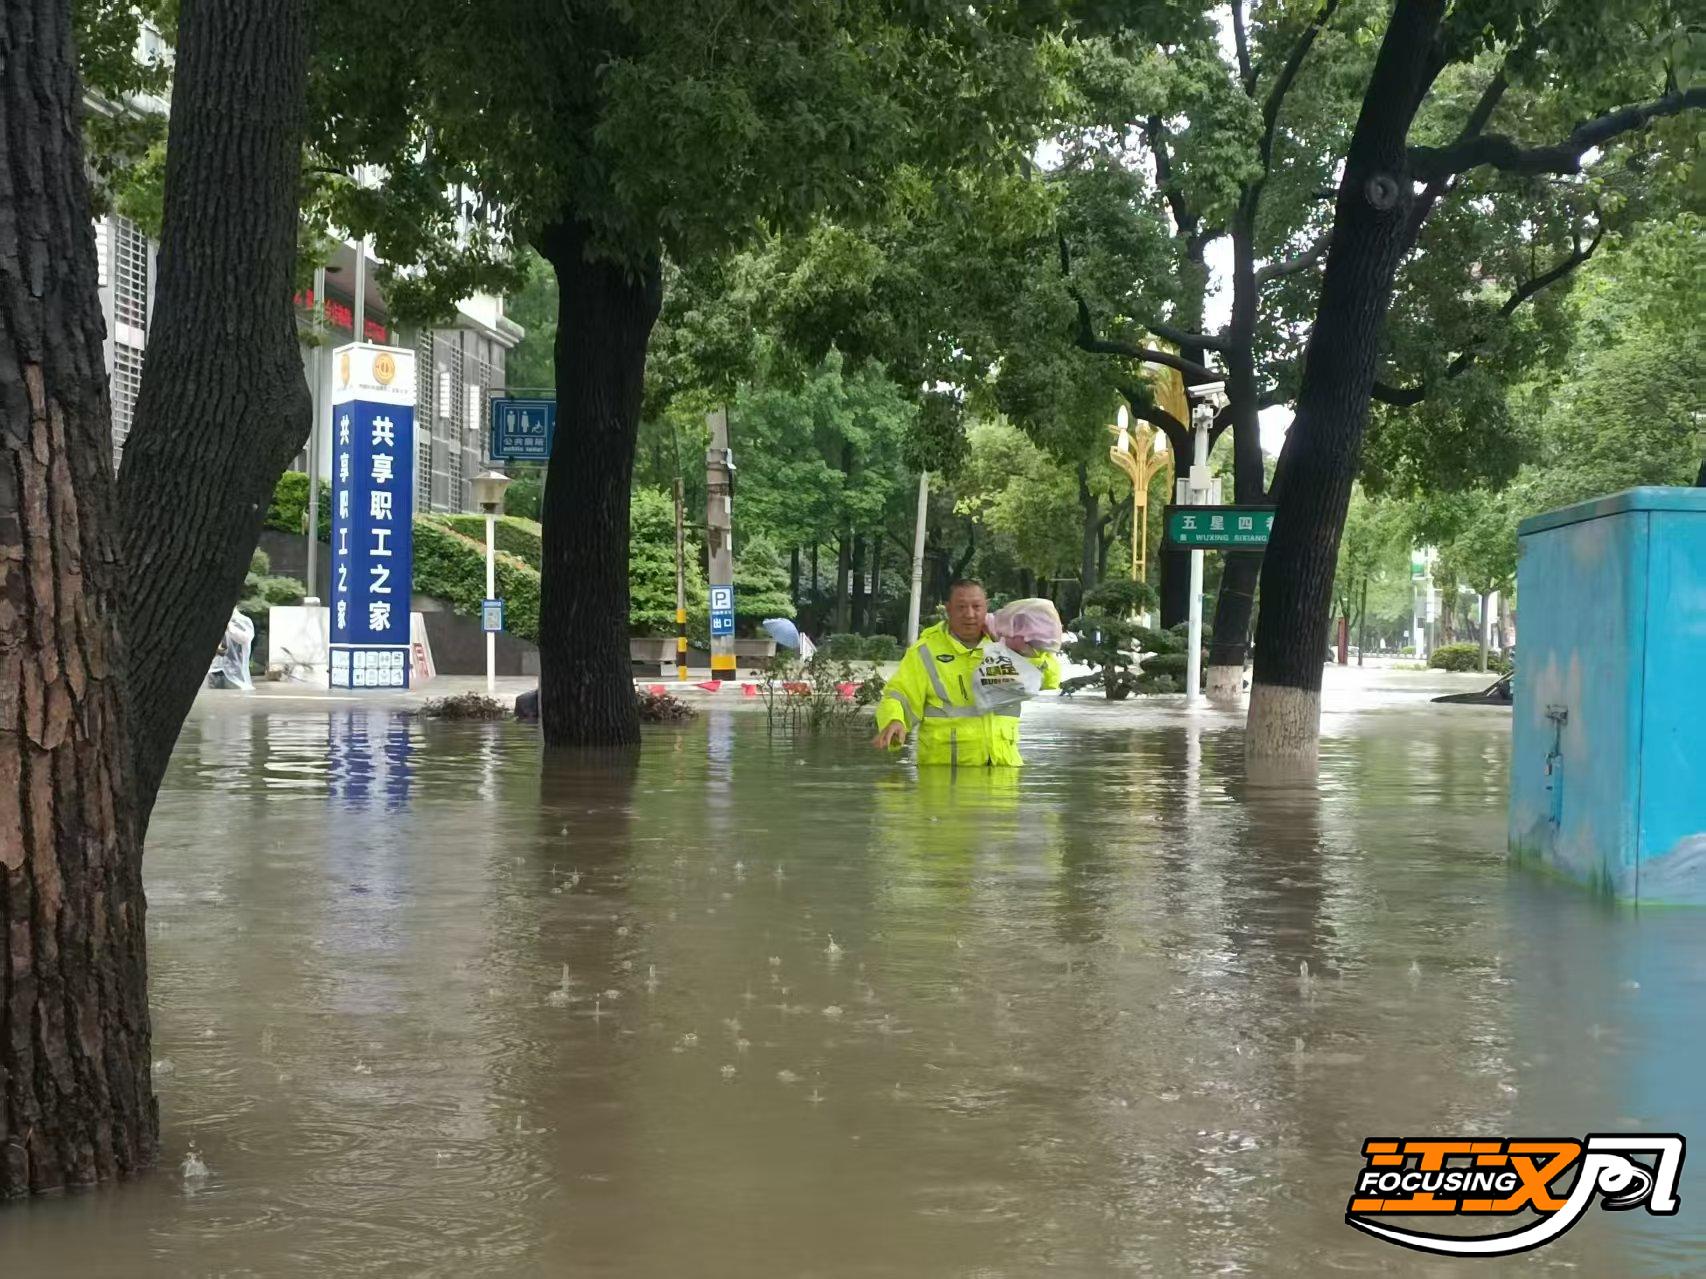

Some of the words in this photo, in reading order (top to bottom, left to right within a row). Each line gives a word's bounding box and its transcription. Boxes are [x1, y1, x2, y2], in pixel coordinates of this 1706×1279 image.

[338, 414, 350, 630] 共享职工之家
[370, 415, 395, 632] 共享职工之家
[1234, 534, 1267, 542] SIXIANG
[715, 591, 726, 605] P
[713, 617, 731, 629] 出口
